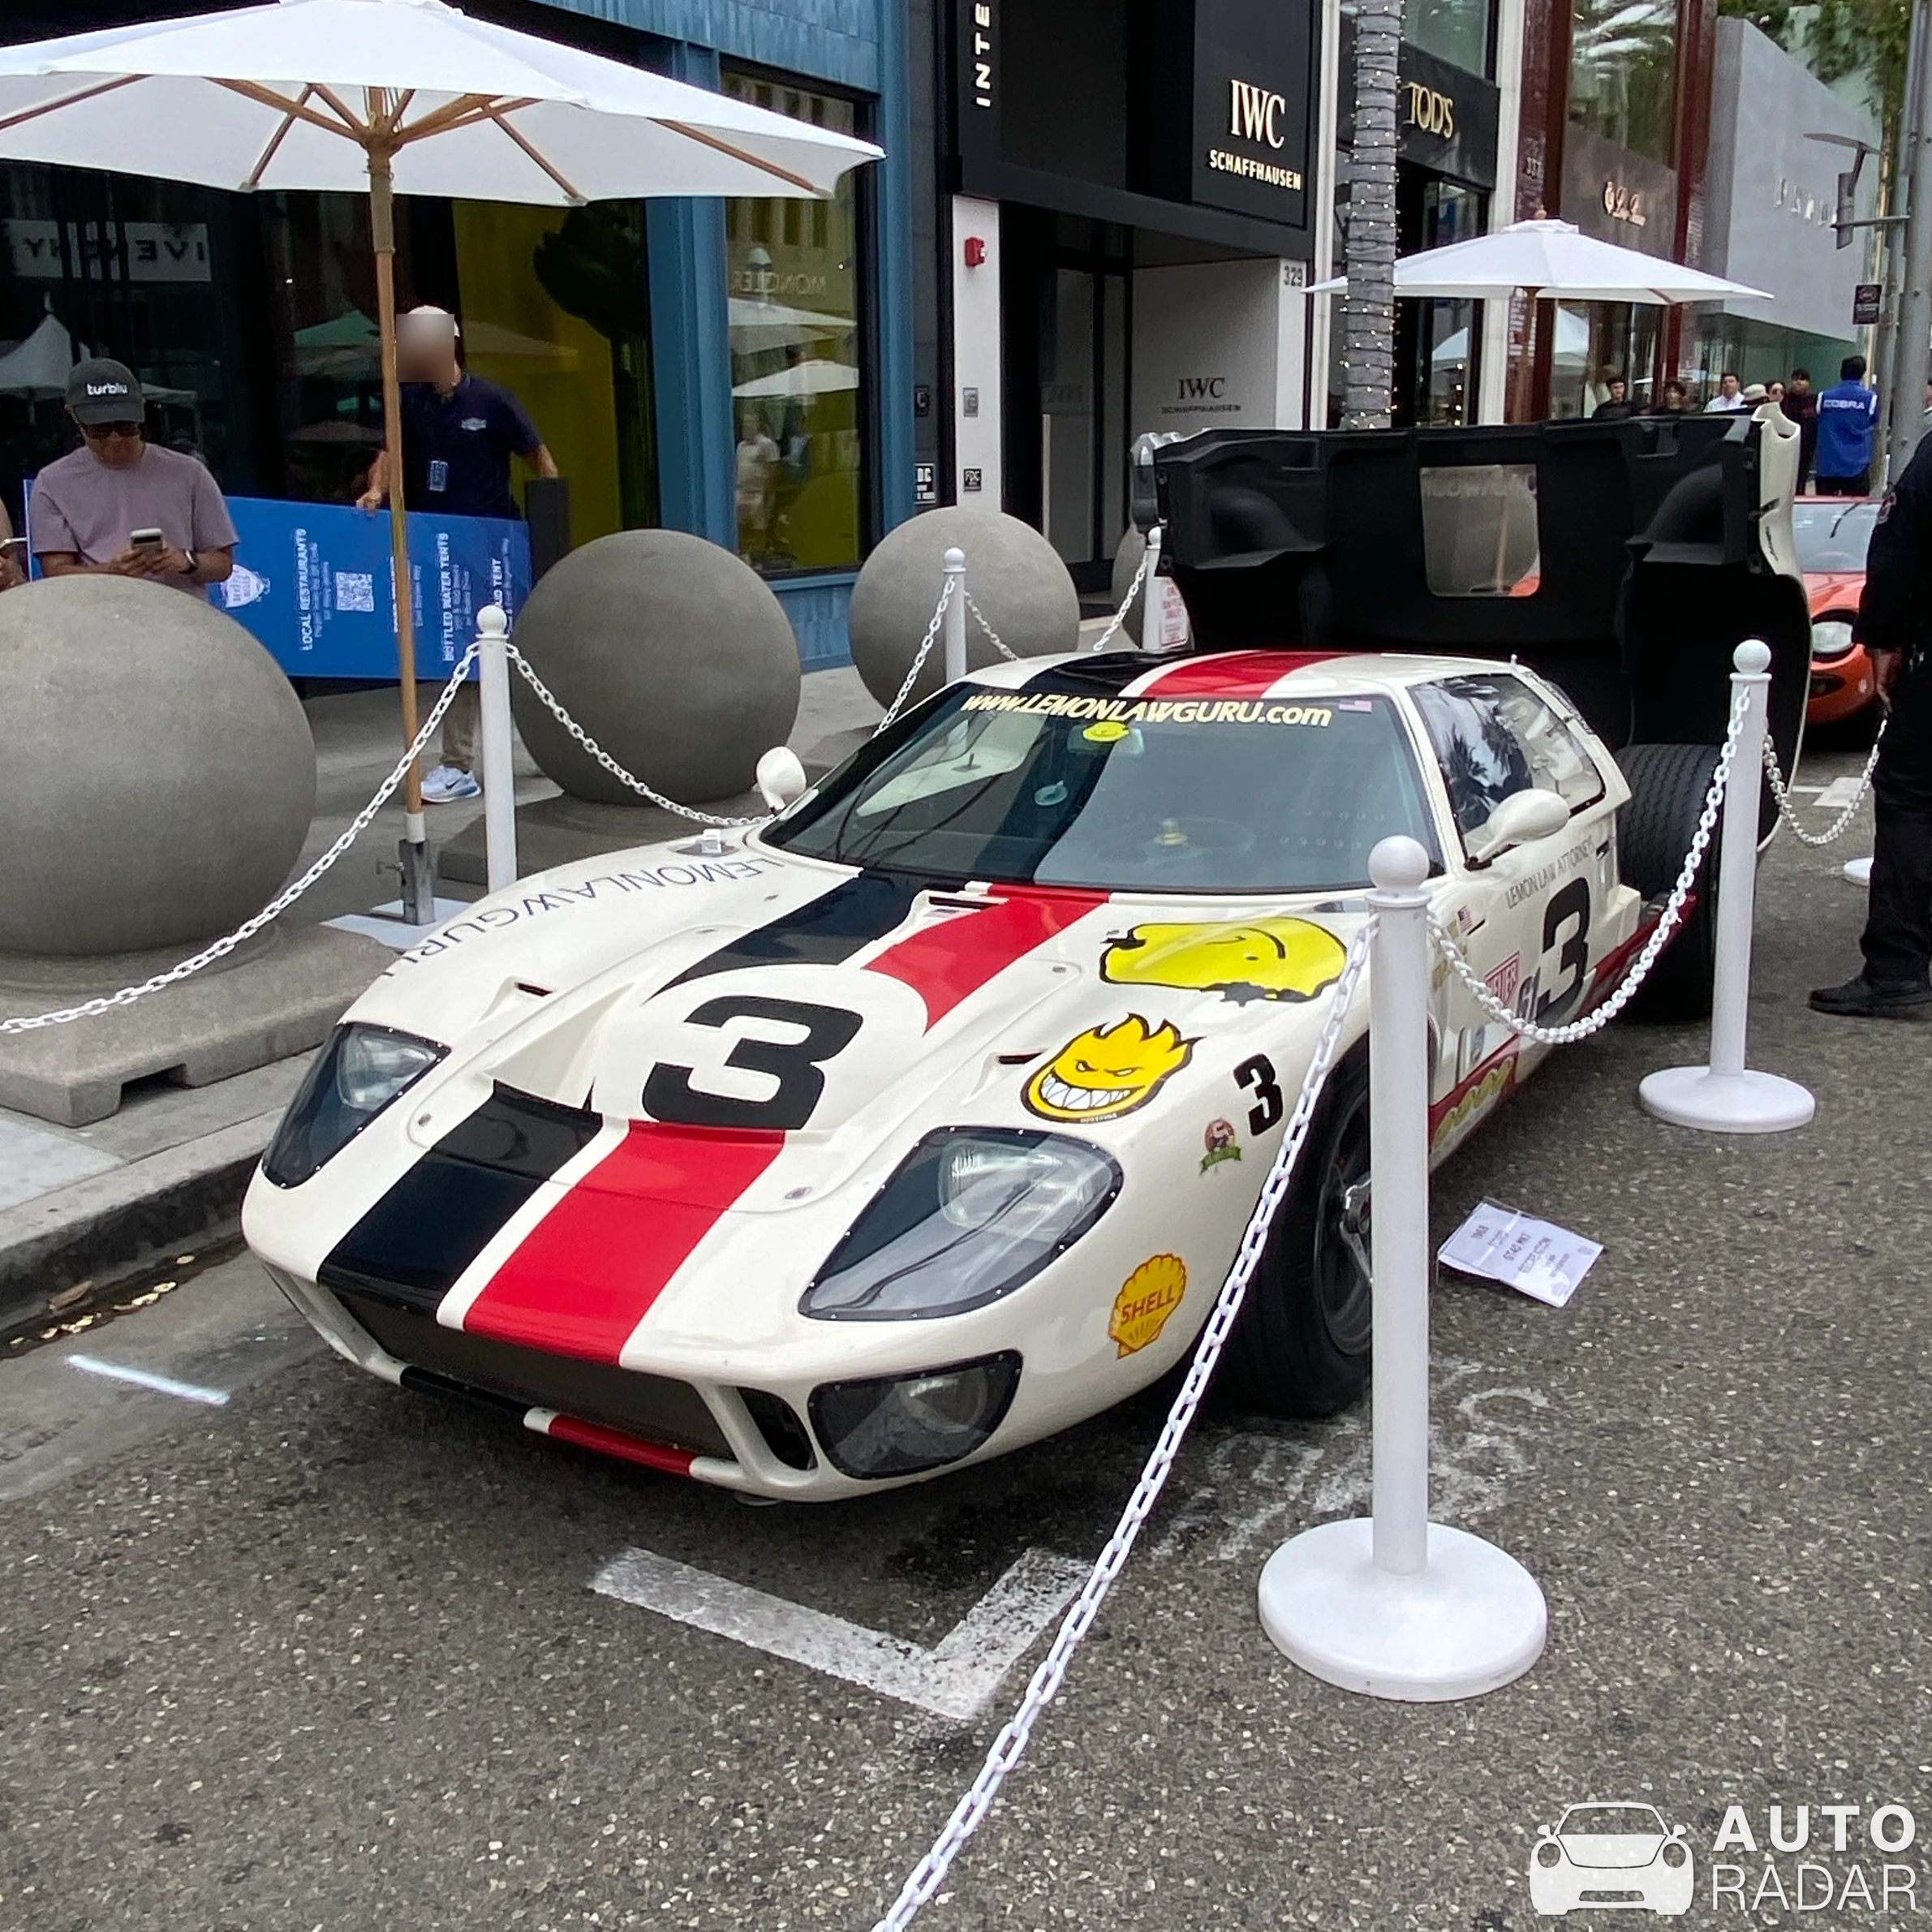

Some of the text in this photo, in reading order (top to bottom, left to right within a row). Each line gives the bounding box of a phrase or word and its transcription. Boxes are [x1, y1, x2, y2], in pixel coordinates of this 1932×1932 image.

[975, 4, 992, 108] INTE
[1230, 80, 1286, 149] IWC
[1209, 148, 1302, 191] SCHAFFHAUSEN
[1283, 265, 1303, 286] 329
[1177, 377, 1226, 400] IWC
[1822, 399, 1865, 410] COBRA
[294, 528, 311, 611] RESTAURANTS
[490, 557, 502, 587] TENT
[297, 613, 313, 652] LOCAL
[1536, 876, 1590, 1028] 3
[642, 995, 863, 1131] 3
[1233, 1053, 1285, 1136] 3
[1120, 1284, 1176, 1325] SHELL
